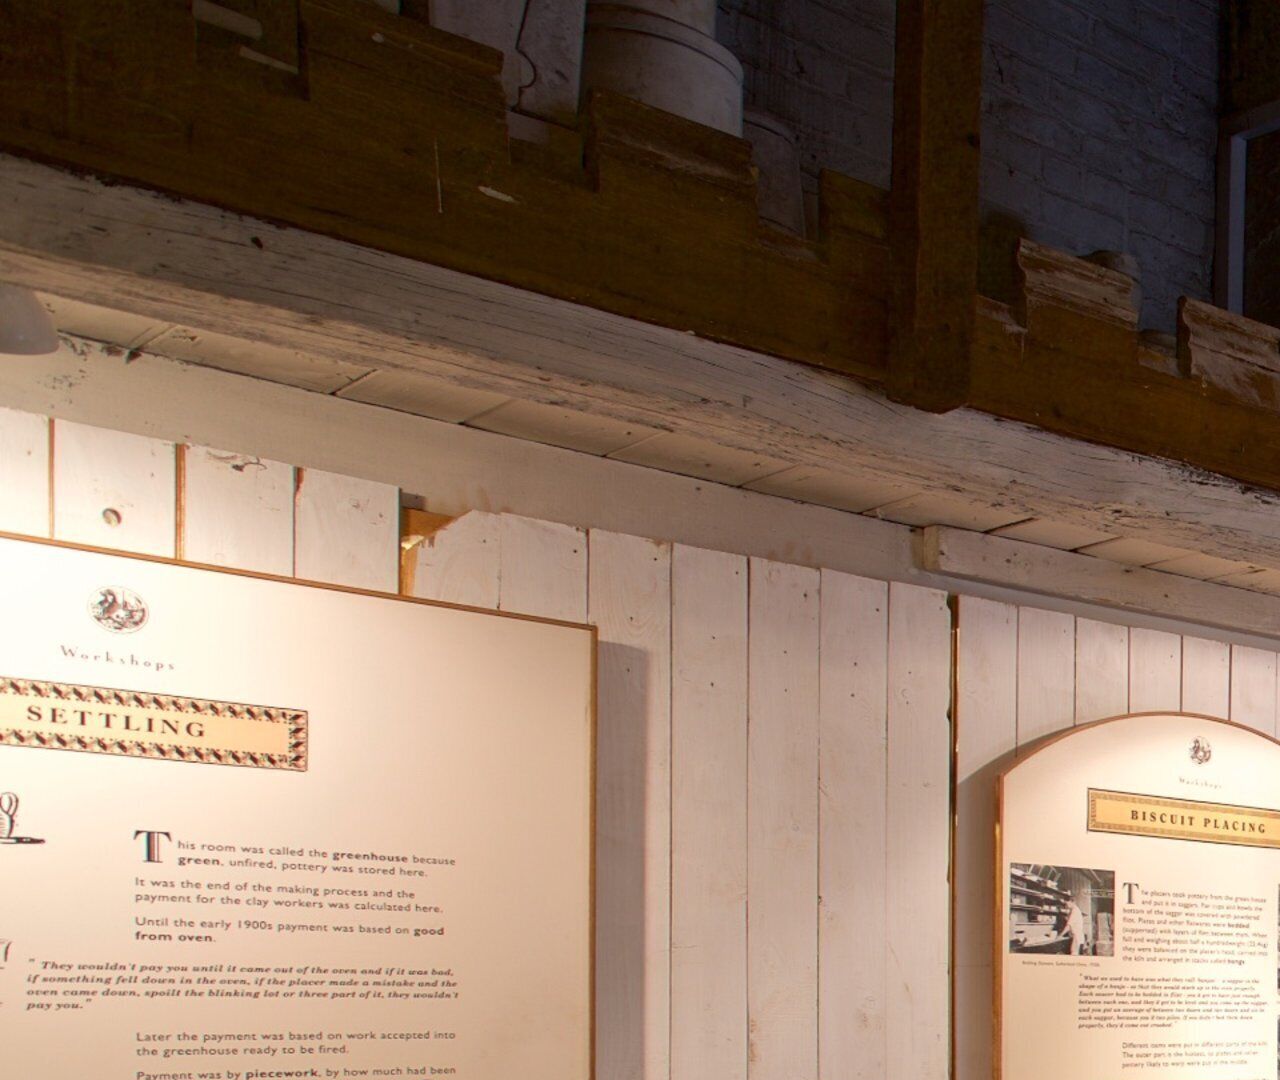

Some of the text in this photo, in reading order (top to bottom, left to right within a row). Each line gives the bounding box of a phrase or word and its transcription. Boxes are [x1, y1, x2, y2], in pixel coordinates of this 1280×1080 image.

[60, 645, 174, 671] Workshops
[27, 706, 204, 737] SETTLING
[1131, 810, 1266, 833] BISCUIT PLACING
[201, 844, 235, 852] room
[269, 847, 304, 856] called
[309, 849, 327, 858] the
[333, 852, 408, 862] greenhouse
[413, 855, 455, 866] because
[282, 863, 327, 873] pottery
[358, 867, 395, 875] stored
[136, 877, 144, 886] It
[181, 880, 201, 889] the
[207, 882, 230, 890] end
[235, 882, 248, 891] of
[252, 883, 272, 892] the
[277, 885, 319, 896] making
[397, 890, 415, 899] the
[135, 894, 191, 904] payment
[196, 894, 215, 903] for
[220, 896, 240, 904] the
[246, 897, 269, 908] clay
[274, 899, 323, 908] workers
[354, 902, 411, 912] calculated
[135, 917, 168, 926] Until
[174, 919, 195, 927] the
[200, 920, 231, 931] early
[238, 920, 272, 930] 1900s
[278, 924, 327, 933] payment
[359, 925, 391, 934] based
[414, 928, 444, 936] good
[135, 931, 172, 941] from
[136, 1032, 171, 1041] Later
[177, 1032, 198, 1041] the
[203, 1034, 257, 1043] payment
[289, 1032, 323, 1040] based
[381, 1031, 430, 1041] accepted
[136, 1047, 158, 1056] the
[163, 1047, 238, 1058] greenhouse
[244, 1046, 278, 1056] ready
[300, 1046, 314, 1054] be
[227, 1070, 240, 1080] by
[326, 1068, 339, 1079] by
[344, 1068, 368, 1076] how
[373, 1067, 402, 1075] much
[407, 1067, 426, 1075] had
[430, 1067, 455, 1075] been
